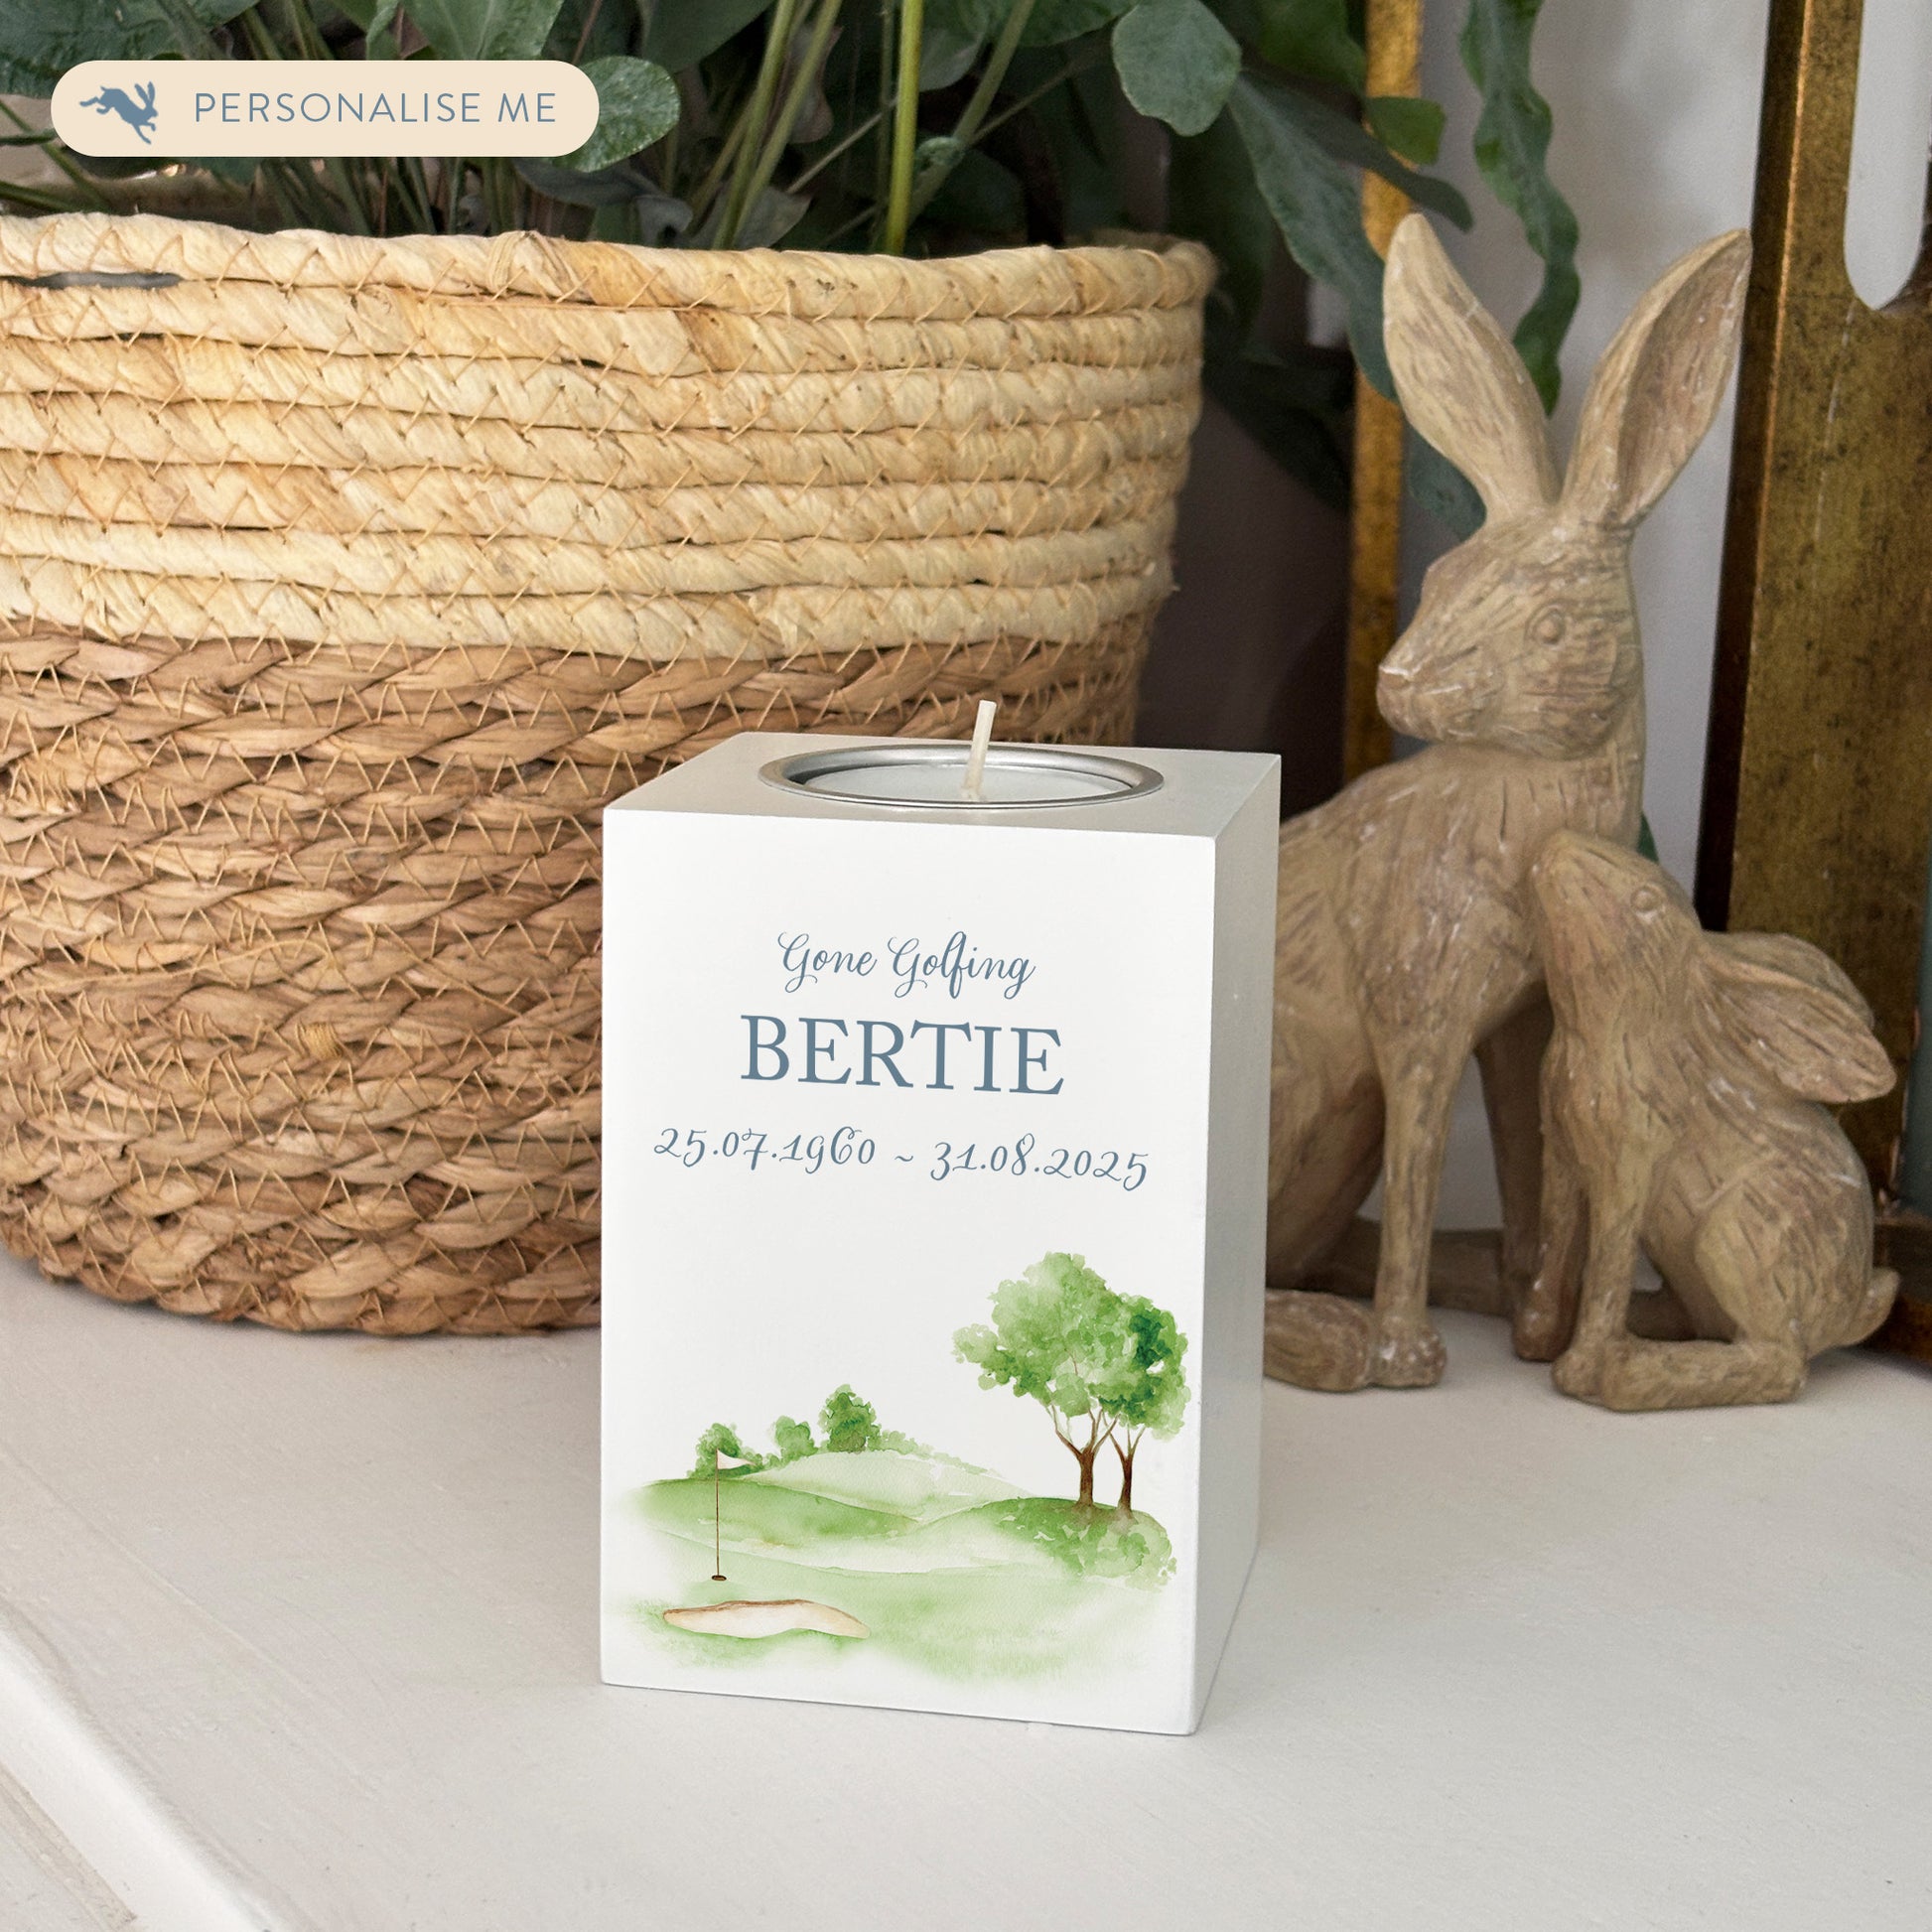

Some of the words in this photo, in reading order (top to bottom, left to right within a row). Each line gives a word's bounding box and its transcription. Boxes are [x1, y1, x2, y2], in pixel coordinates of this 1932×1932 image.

[777, 931, 878, 994] Gone
[887, 930, 1036, 1001] Golfing
[740, 1014, 1064, 1096] BERTIE
[653, 1126, 876, 1174] 25.07.1960
[929, 1132, 1150, 1192] 31.08.2025
